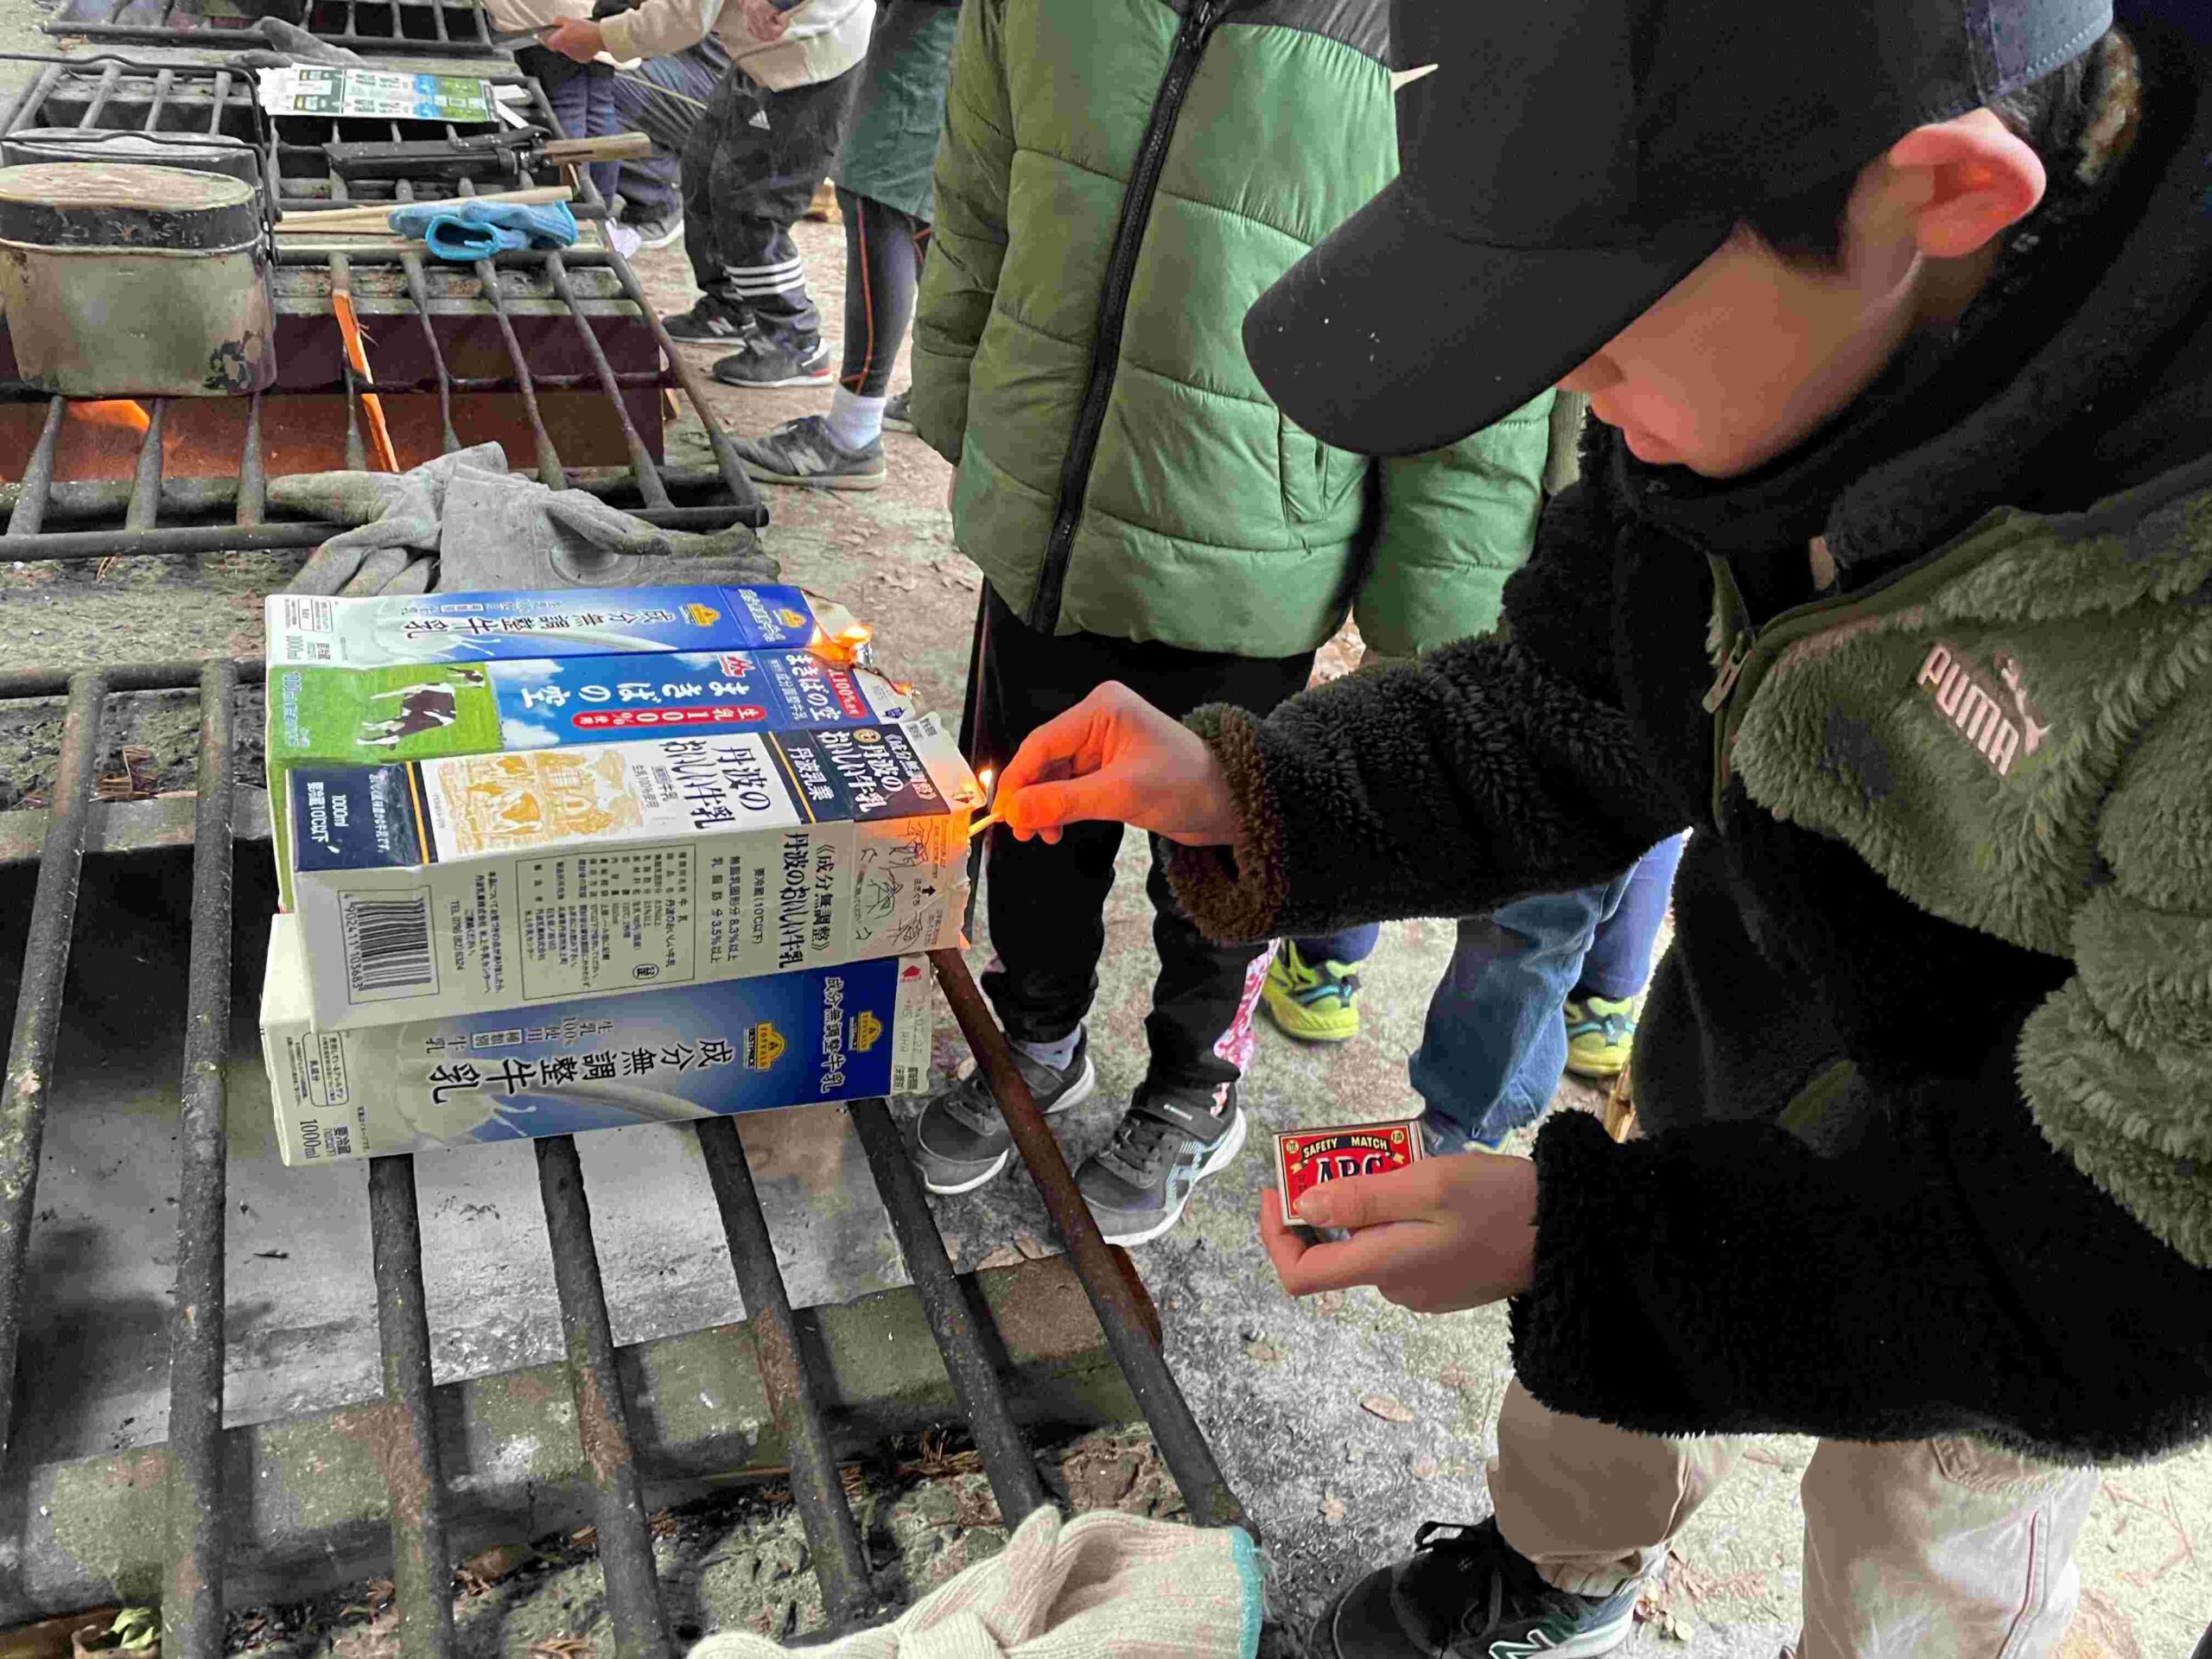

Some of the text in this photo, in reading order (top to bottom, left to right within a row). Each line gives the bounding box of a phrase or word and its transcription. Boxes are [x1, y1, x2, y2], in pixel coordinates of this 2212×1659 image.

[520, 680, 750, 709] まきばの空
[785, 654, 842, 721] まきばの空
[1916, 646, 2019, 776] PUMA
[659, 741, 736, 830] おいしい牛乳
[711, 747, 771, 811] 丹波の
[787, 747, 834, 801] 丹波乳業
[817, 732, 887, 812] おいしい牛乳
[858, 745, 905, 792] 丹波の
[332, 794, 350, 827] 1000ml
[451, 900, 460, 914] TEL
[779, 833, 810, 969] 丹波のおいしい牛乳
[811, 844, 836, 951] 《成分無調整》
[349, 951, 361, 989] 103683
[426, 1036, 467, 1053] 牛乳
[821, 976, 846, 1094] 成分無調整牛乳
[429, 1040, 734, 1105] 成分無調整牛乳
[300, 1119, 321, 1160] 1000ml
[1302, 1136, 1388, 1159] SAFETY MATCH
